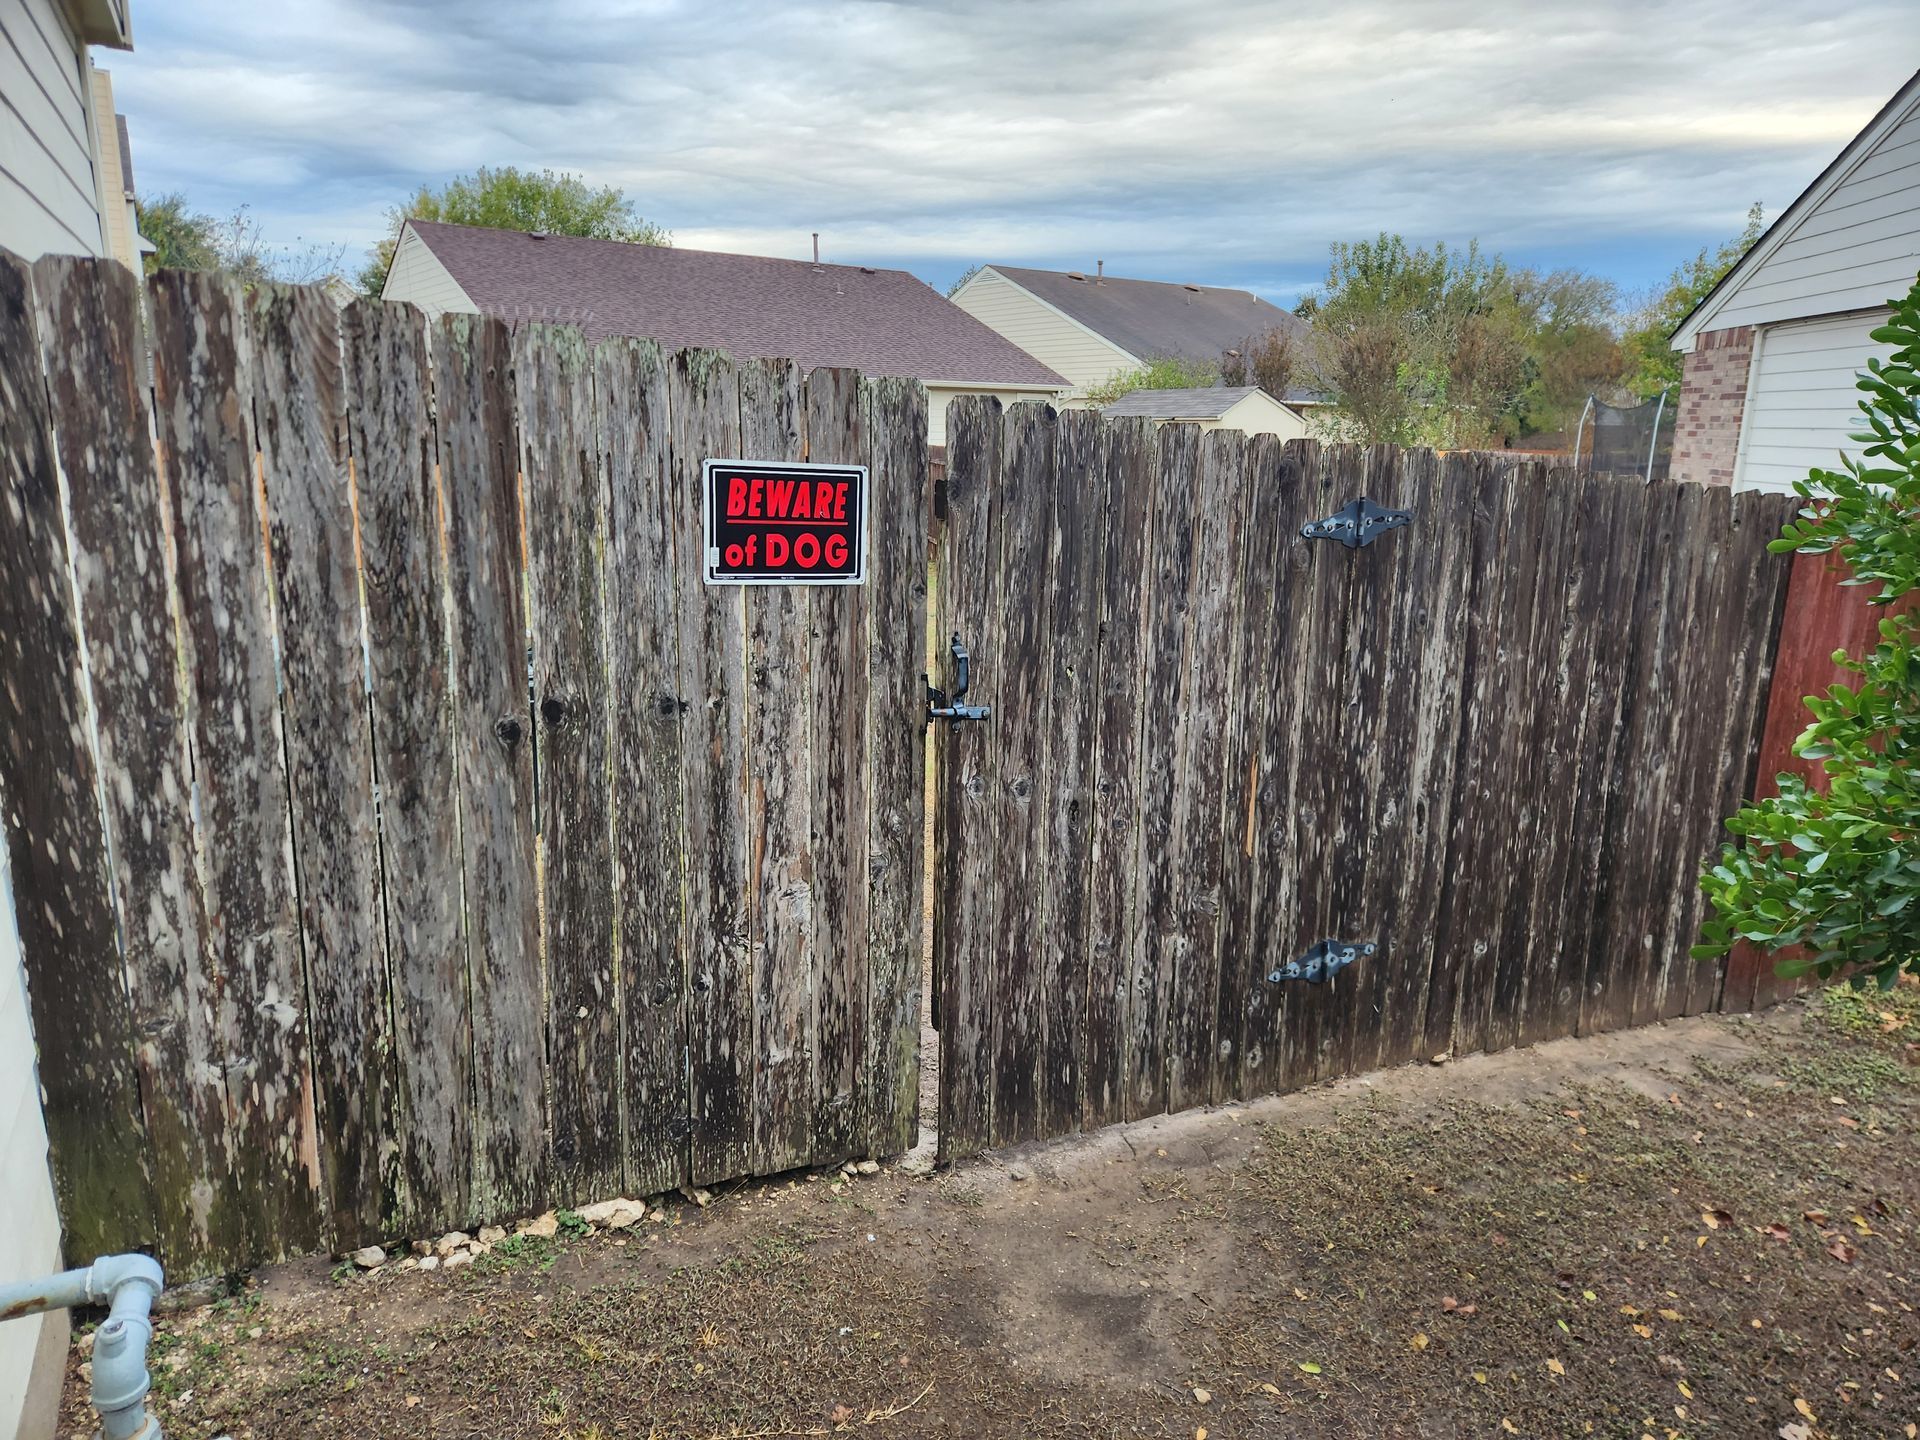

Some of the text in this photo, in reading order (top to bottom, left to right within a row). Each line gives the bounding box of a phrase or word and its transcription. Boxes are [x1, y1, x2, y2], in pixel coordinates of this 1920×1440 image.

[727, 478, 848, 519] BEWARE
[725, 534, 757, 567] of
[766, 533, 848, 568] DOG
